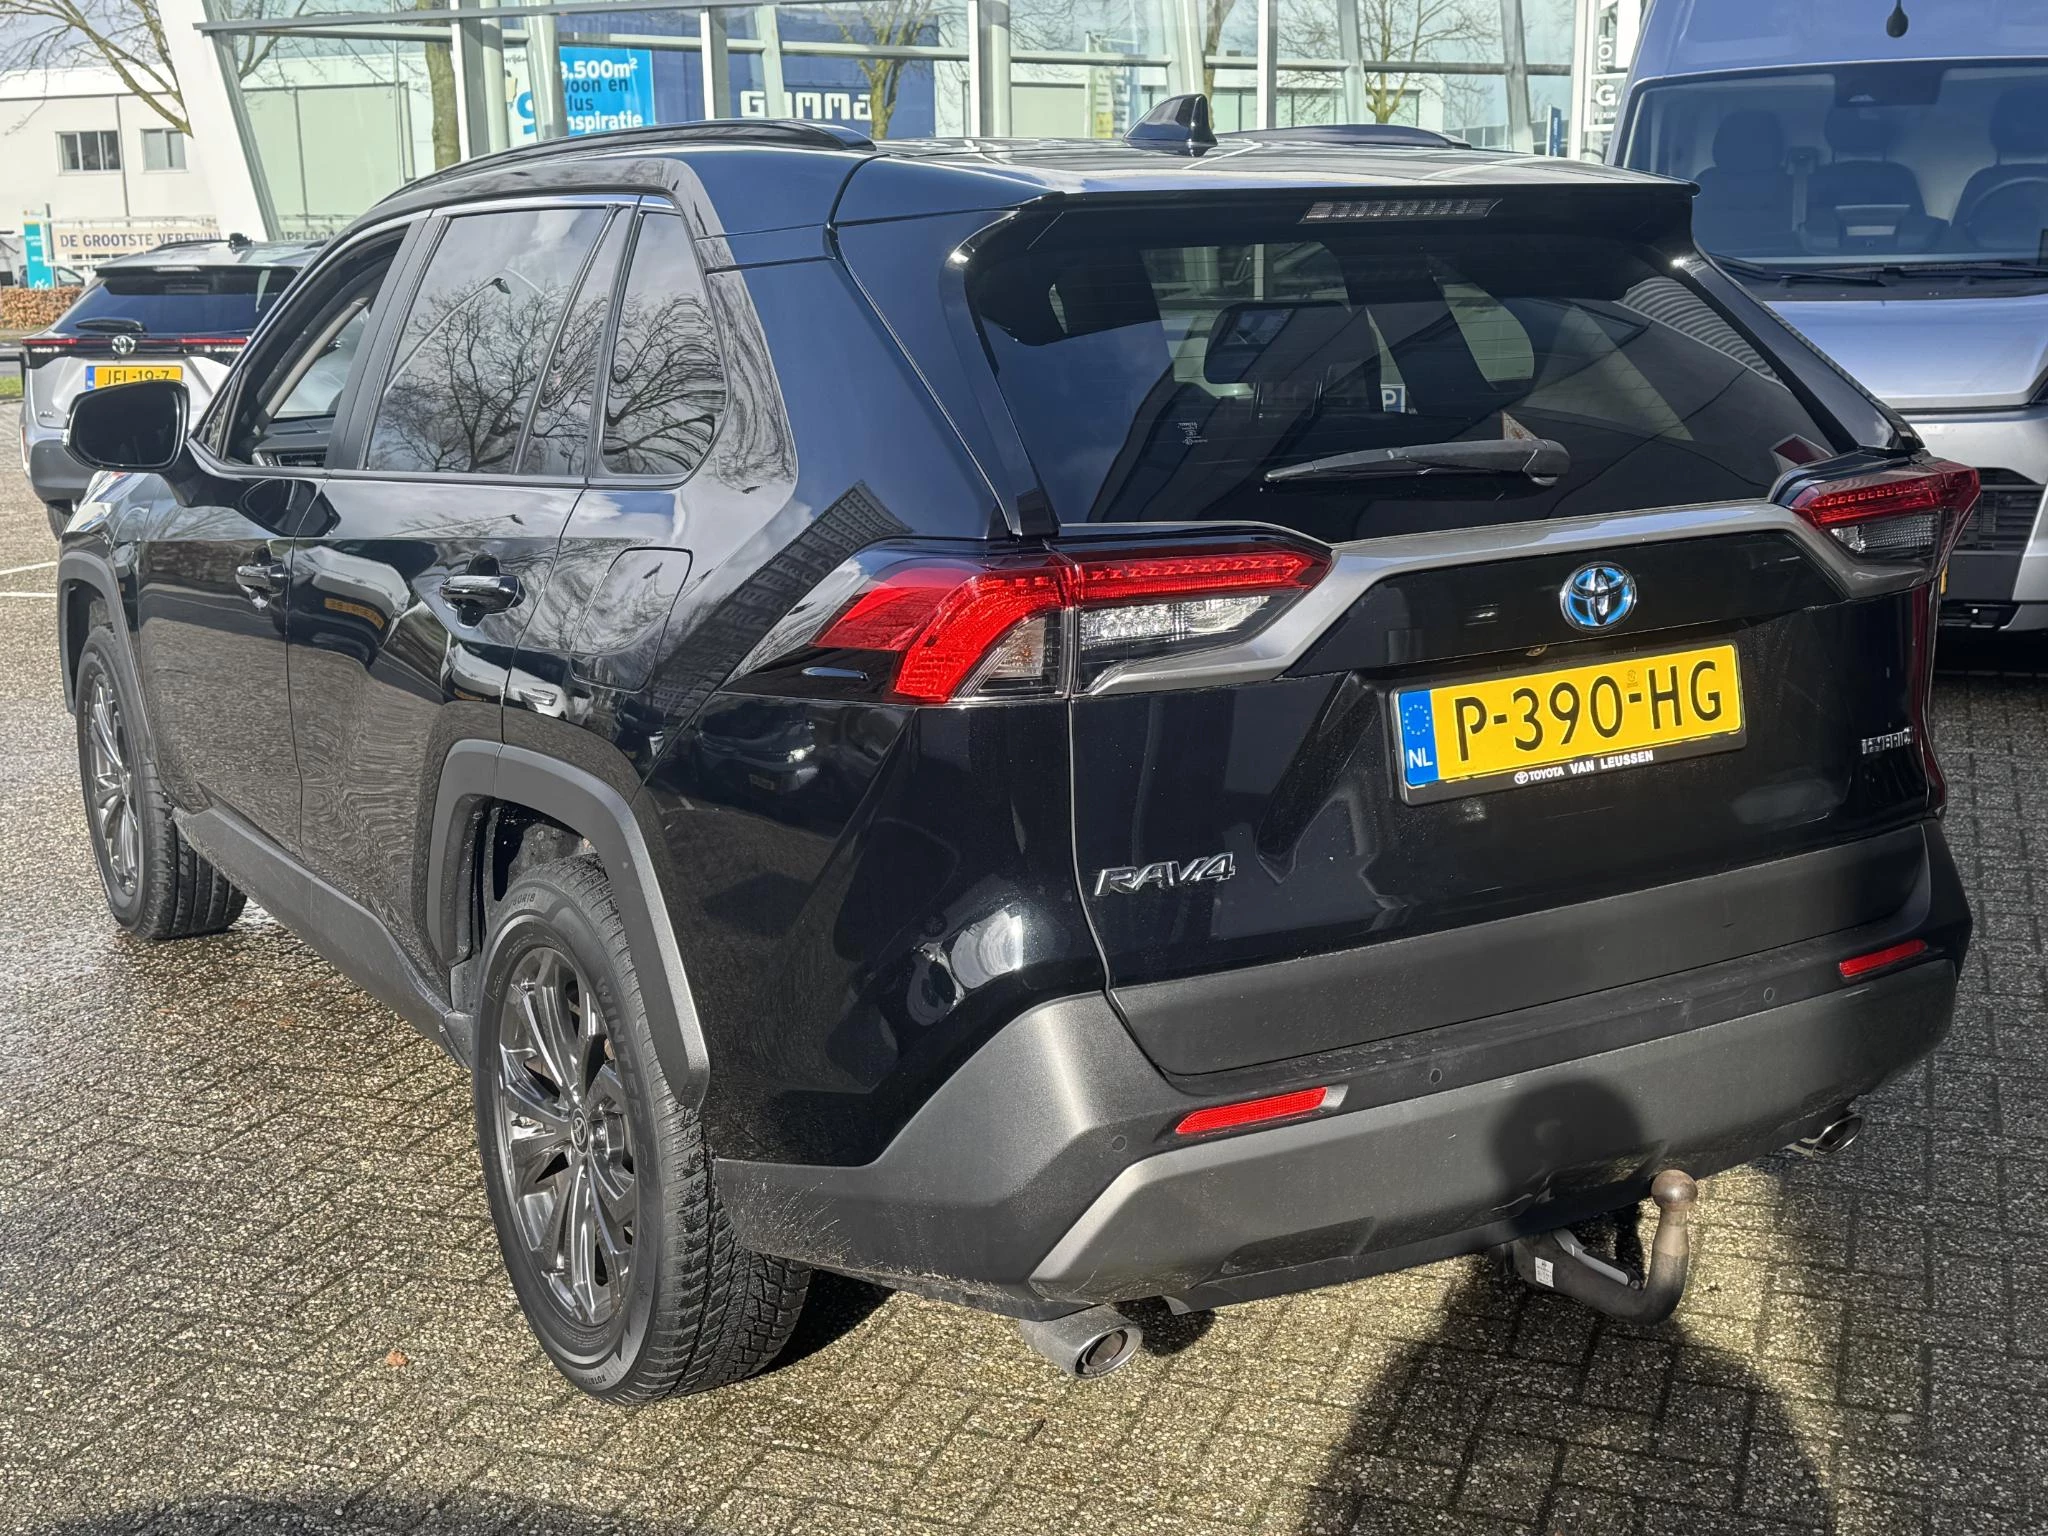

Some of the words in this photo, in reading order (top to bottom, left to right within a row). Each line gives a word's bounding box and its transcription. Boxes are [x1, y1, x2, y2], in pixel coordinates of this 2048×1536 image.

[608, 79, 629, 92] en
[568, 96, 594, 112] lus
[567, 111, 644, 133] nspiratie
[60, 234, 78, 247] DE
[83, 233, 153, 247] GROOTSTE
[1454, 660, 1723, 762] P-390-HG
[1408, 747, 1434, 770] NL
[1529, 766, 1565, 781] TOYOTA
[1569, 760, 1595, 775] VAN
[1600, 750, 1654, 769] LEUSSEN
[1094, 851, 1236, 897] RAV4
